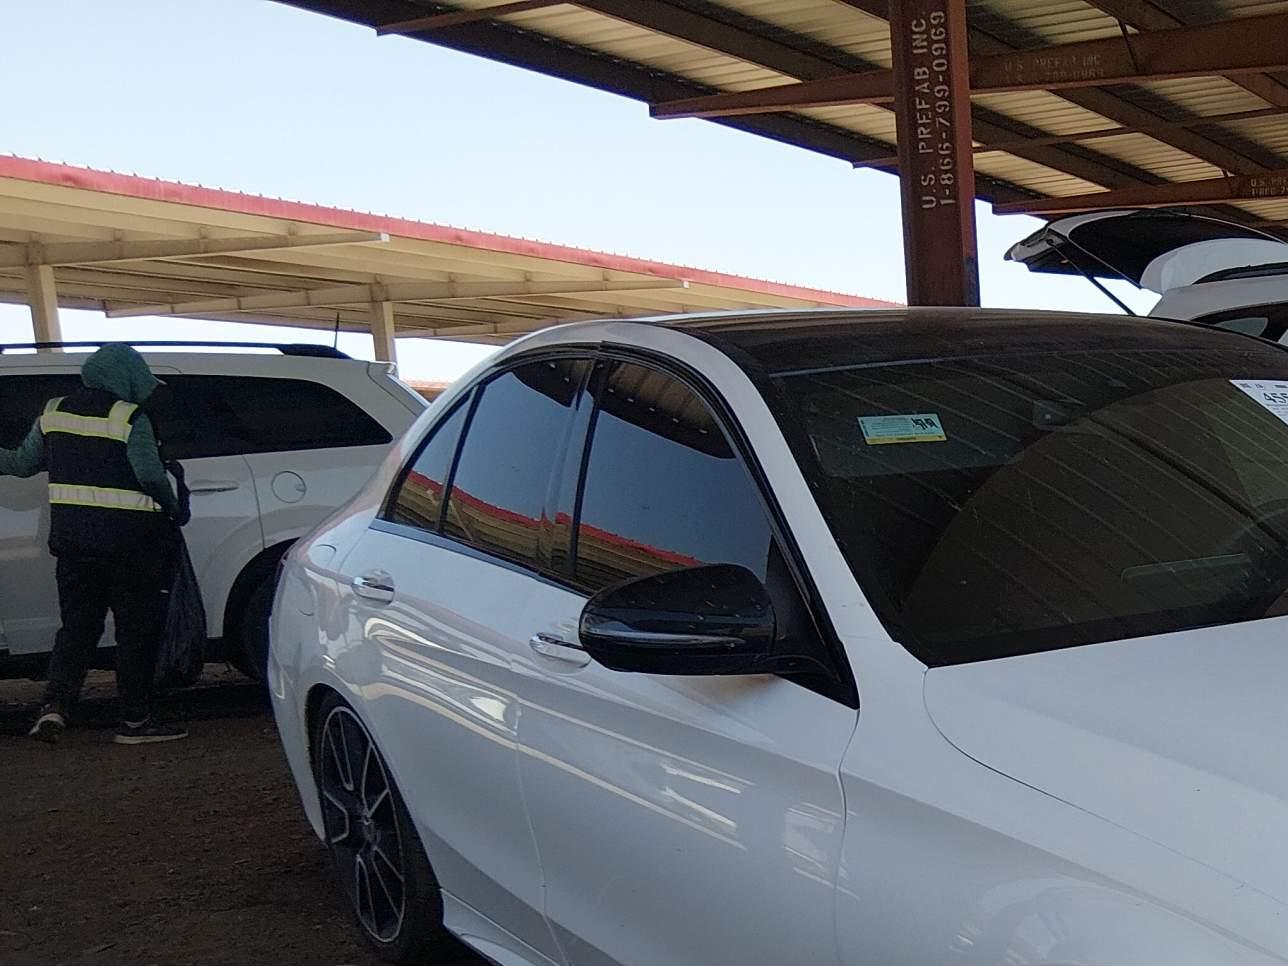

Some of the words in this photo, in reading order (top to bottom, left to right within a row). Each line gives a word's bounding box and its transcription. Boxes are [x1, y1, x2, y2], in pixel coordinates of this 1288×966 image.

[914, 66, 934, 154] PREFAB
[930, 10, 956, 206] 1-866-799-0969
[921, 166, 937, 209] U.S.
